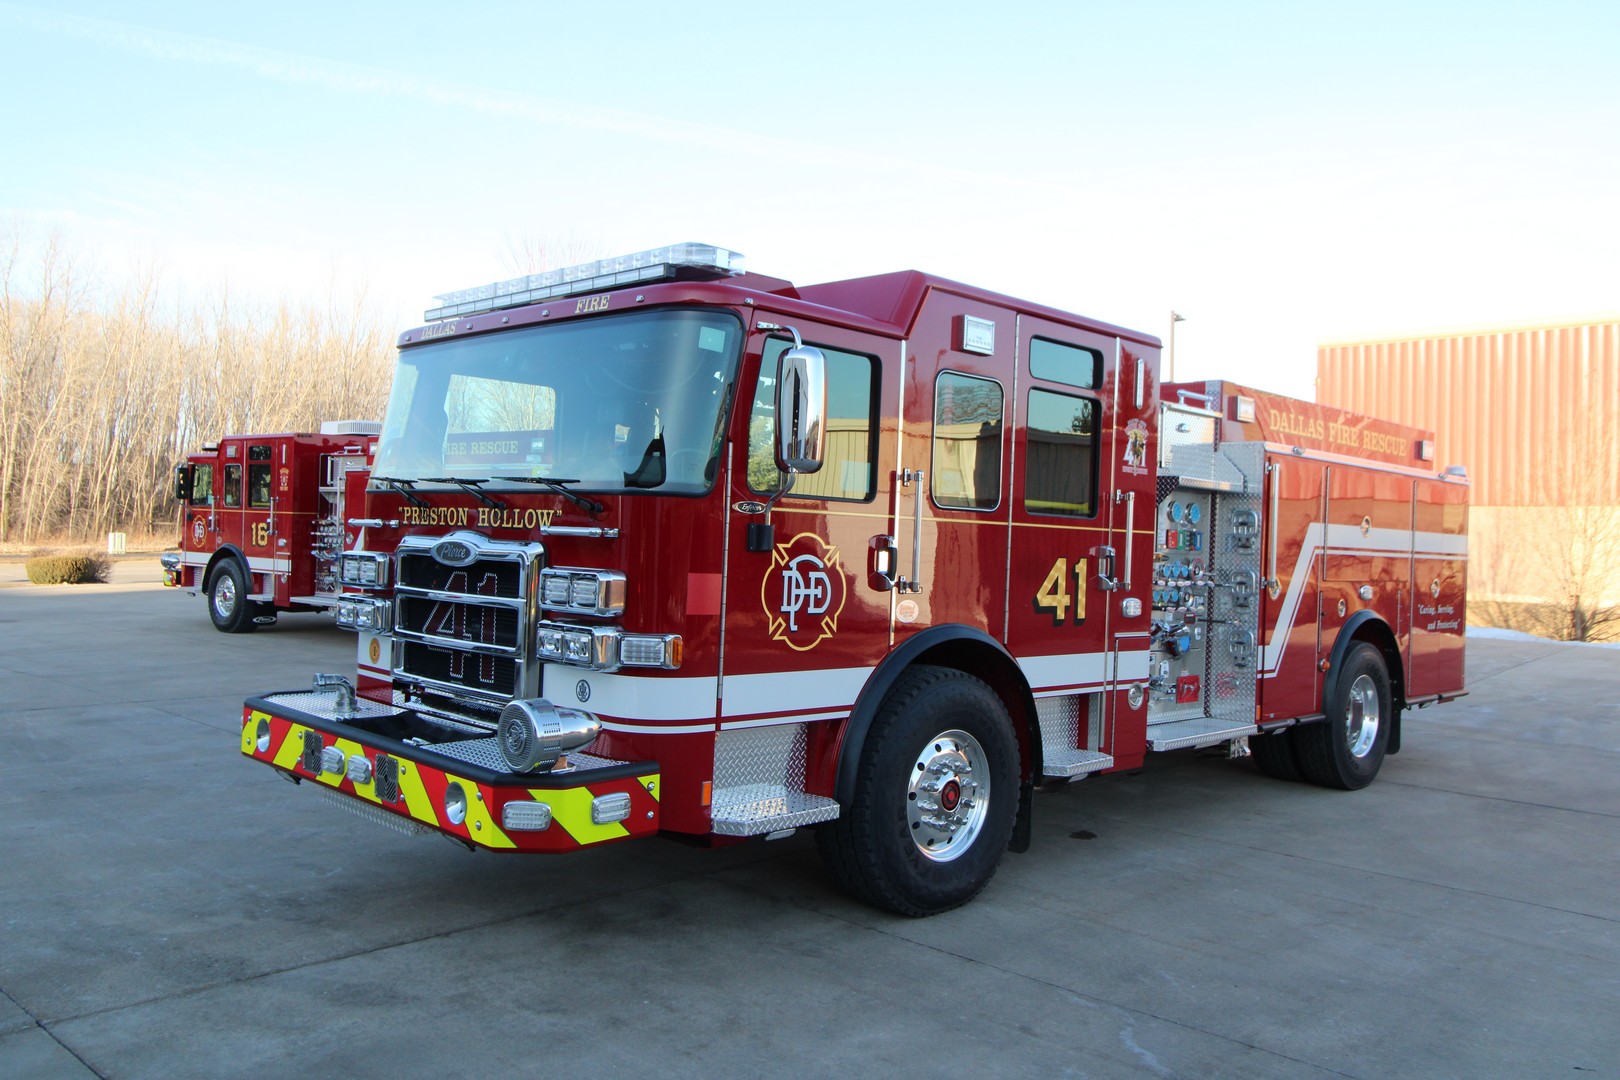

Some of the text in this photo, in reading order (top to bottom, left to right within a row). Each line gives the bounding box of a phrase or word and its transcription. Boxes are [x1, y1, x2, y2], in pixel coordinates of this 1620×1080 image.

[575, 294, 611, 314] FIRE
[421, 322, 457, 340] DALLAS
[1269, 409, 1408, 457] DALLAS FIRE RESCUE
[445, 440, 518, 455] IRE RESCUE
[251, 522, 268, 546] 16
[1034, 556, 1089, 624] 41
